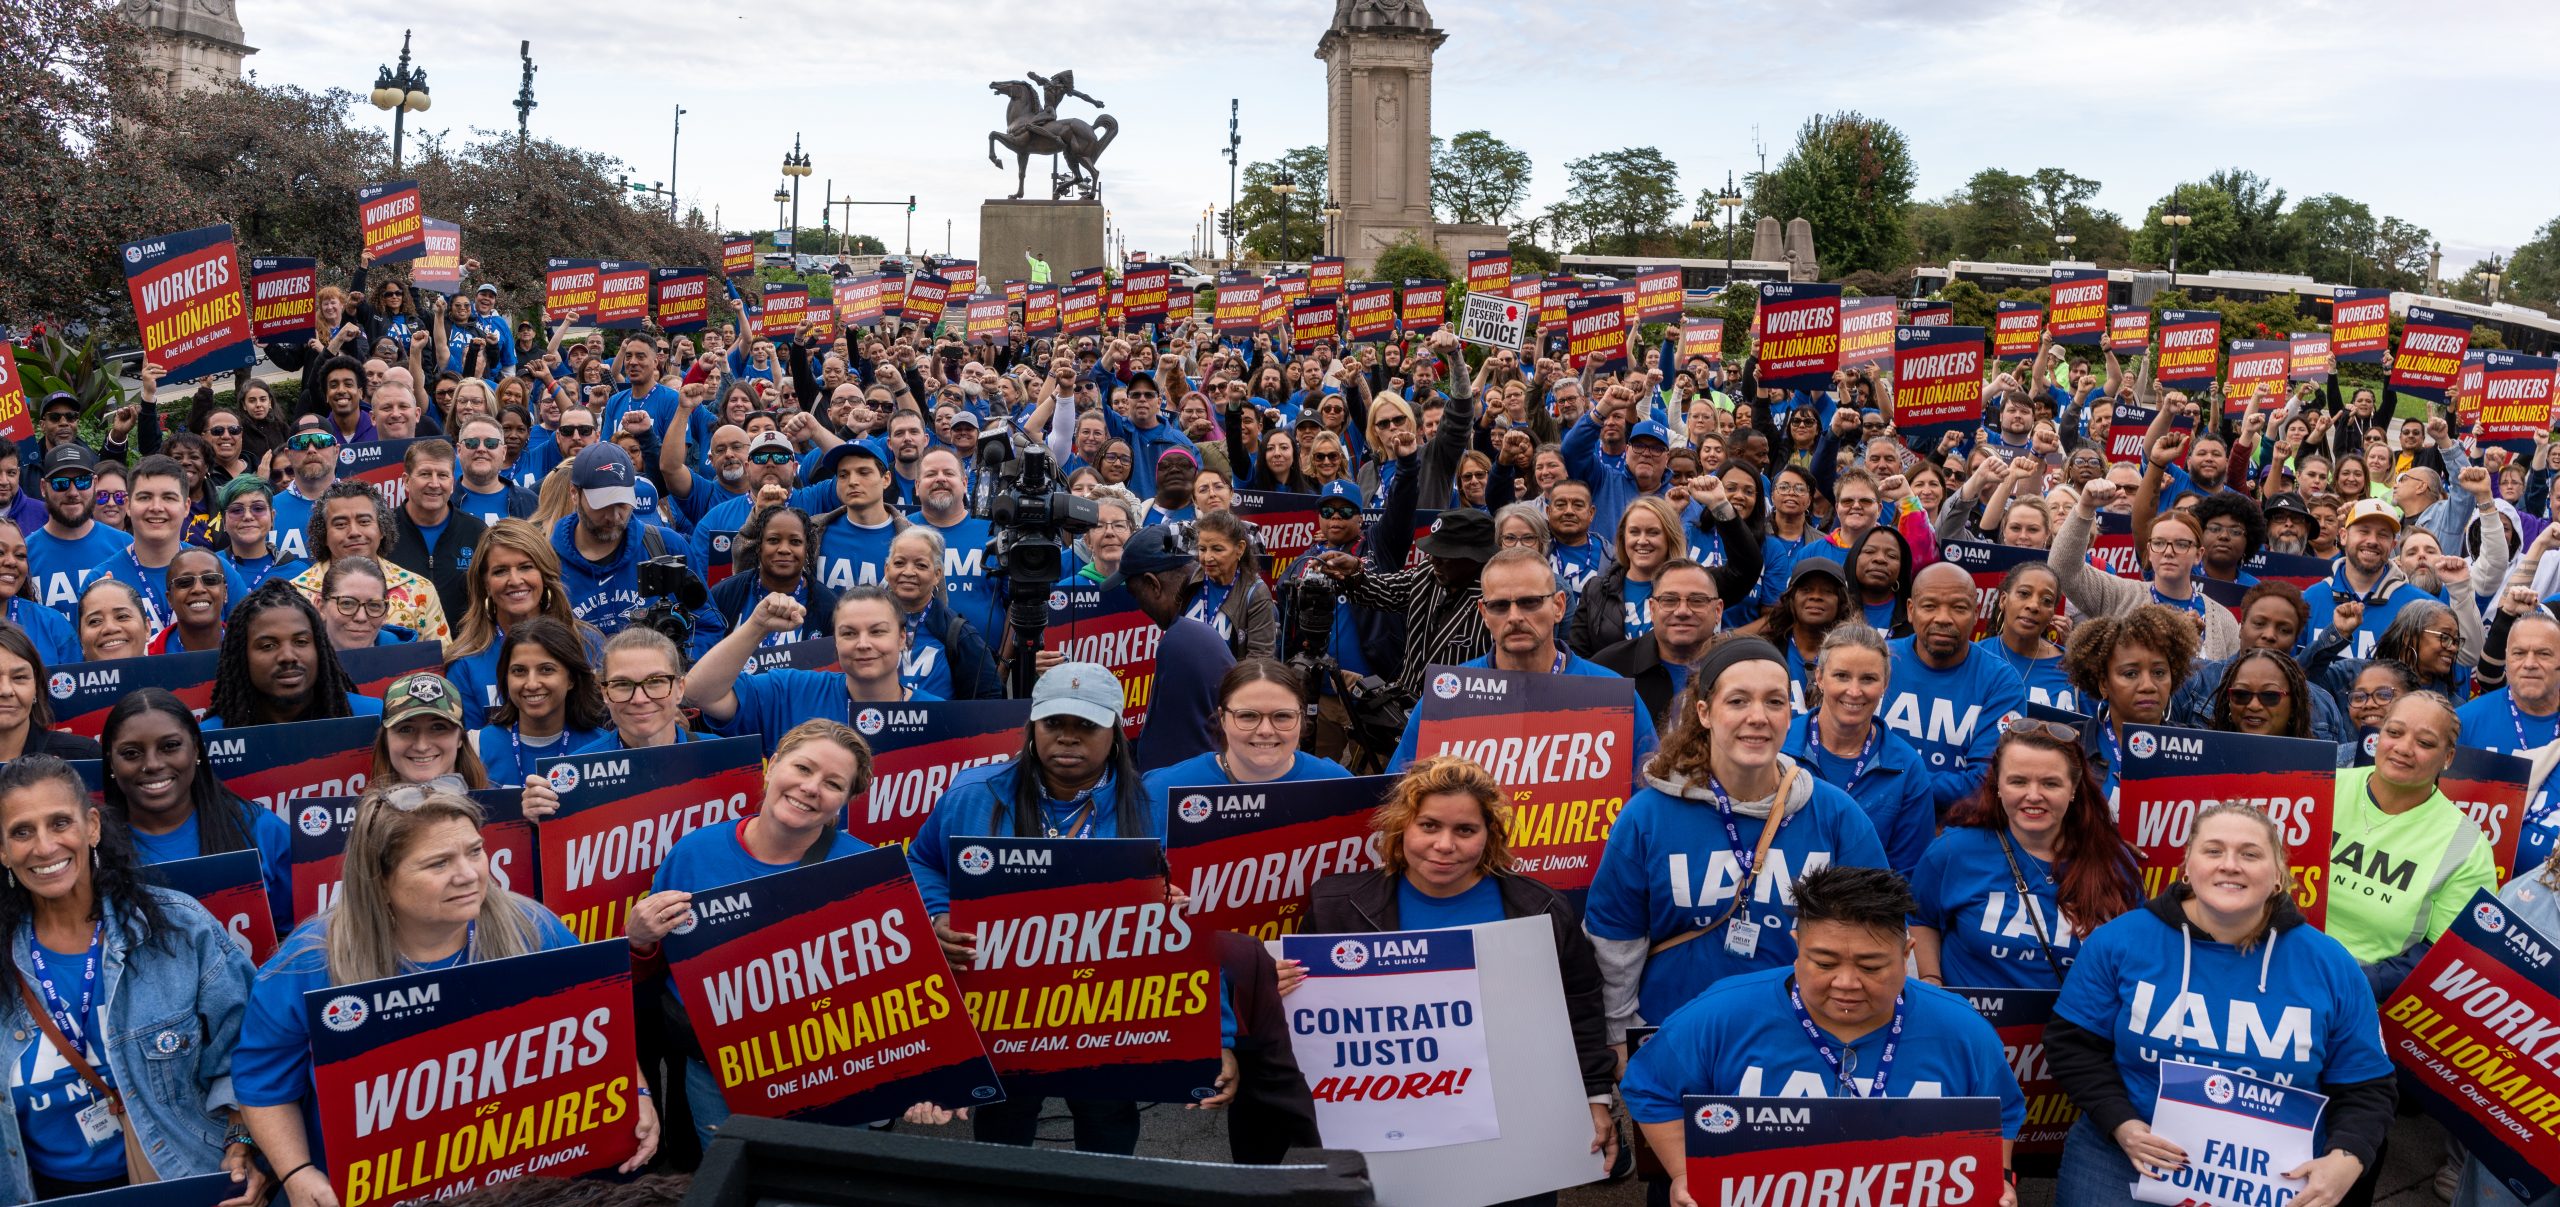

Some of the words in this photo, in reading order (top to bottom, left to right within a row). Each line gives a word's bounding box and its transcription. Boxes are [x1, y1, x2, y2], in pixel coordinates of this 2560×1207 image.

[366, 196, 414, 226] WORKERS
[366, 214, 420, 246] BILLIONAIRES
[142, 241, 166, 254] IAM
[725, 244, 751, 256] WORKERS
[724, 254, 752, 267] BILLIONAIRES
[1313, 266, 1342, 276] WORKERS
[141, 256, 229, 314] WORKERS
[257, 276, 310, 300] WORKERS
[551, 273, 594, 291] WORKERS
[602, 276, 645, 294] WORKERS
[662, 282, 703, 299] WORKERS
[1311, 276, 1342, 288] BILLIONAIRES
[1640, 276, 1678, 293] WORKERS
[548, 290, 597, 309] BILLIONAIRES
[599, 292, 647, 311] BILLIONAIRES
[844, 285, 879, 301] WORKERS
[912, 285, 946, 300] WORKERS
[1220, 289, 1259, 304] WORKERS
[1406, 288, 1441, 304] WORKERS
[1638, 291, 1680, 308] BILLIONAIRES
[2055, 285, 2103, 304] WORKERS
[254, 298, 314, 322] BILLIONAIRES
[659, 298, 706, 316] BILLIONAIRES
[766, 297, 804, 311] WORKERS
[842, 299, 881, 314] BILLIONAIRES
[906, 299, 944, 313] BILLIONAIRES
[1062, 294, 1096, 310] WORKERS
[1216, 303, 1260, 318] BILLIONAIRES
[1352, 294, 1390, 310] WORKERS
[1403, 302, 1442, 319] BILLIONAIRES
[1471, 298, 1503, 312] DRIVERS
[971, 305, 1005, 318] WORKERS
[1064, 308, 1099, 324] BILLIONAIRES
[1297, 310, 1332, 325] WORKERS
[1350, 309, 1392, 326] BILLIONAIRES
[1469, 308, 1505, 323] DESERVE
[1766, 306, 1834, 334] WORKERS
[2052, 304, 2105, 324] BILLIONAIRES
[2338, 304, 2385, 323] WORKERS
[146, 291, 241, 352] BILLIONAIRES
[968, 317, 1006, 331] BILLIONAIRES
[1572, 310, 1619, 336] WORKERS
[1842, 311, 1892, 333] WORKERS
[2000, 316, 2038, 330] WORKERS
[2114, 316, 2147, 328] WORKERS
[1468, 319, 1473, 327] A
[1475, 321, 1518, 344] VOICE
[1840, 329, 1896, 352] BILLIONAIRES
[1912, 330, 1930, 338] IAM
[1996, 329, 2039, 344] BILLIONAIRES
[2164, 328, 2214, 348] WORKERS
[2334, 322, 2386, 342] BILLIONAIRES
[1571, 330, 1624, 355] BILLIONAIRES
[1761, 334, 1838, 360] BILLIONAIRES
[2404, 331, 2463, 354] WORKERS
[1902, 351, 1976, 381] WORKERS
[2160, 348, 2215, 367] BILLIONAIRES
[2396, 354, 2460, 375] BILLIONAIRES
[2498, 355, 2514, 363] IAM
[2233, 358, 2283, 378] WORKERS
[1896, 380, 1980, 408] BILLIONAIRES
[2487, 378, 2549, 400] WORKERS
[2128, 409, 2145, 418] IAM
[2482, 404, 2548, 423] BILLIONAIRES
[1652, 425, 1665, 433] IAM
[357, 446, 382, 457] IAM
[1243, 495, 1263, 504] IAM
[1964, 548, 1990, 560] IAM
[573, 592, 608, 619] BLUE
[611, 589, 645, 605] JAYS
[1071, 592, 1099, 603] IAM
[759, 651, 791, 663] IAM
[765, 662, 789, 670] UNION
[79, 669, 120, 687] IAM
[1464, 676, 1507, 694] IAM
[84, 686, 117, 694] UNION
[888, 710, 927, 725] IAM
[2161, 736, 2203, 754] IAM
[584, 759, 630, 779] IAM
[589, 779, 626, 787] UNION
[1217, 794, 1265, 812] IAM
[999, 849, 1052, 867] IAM
[1669, 849, 1831, 908] IAM
[699, 892, 752, 918] IAM
[710, 911, 750, 925] UNION
[974, 903, 1192, 971] WORKERS
[2504, 924, 2552, 967] IAM
[1374, 939, 1428, 958] IAM
[2505, 940, 2538, 969] UNION
[703, 908, 911, 1027] WORKERS
[374, 983, 440, 1012] IAM
[964, 970, 1209, 1032] BILLIONAIRES
[383, 1005, 436, 1020] UNION
[1294, 1001, 1472, 1034] CONTRATO
[2128, 980, 2311, 1062] IAM
[718, 974, 950, 1088] BILLIONAIRES
[1029, 1034, 1070, 1051] IAM.
[1334, 1037, 1438, 1068] JUSTO
[354, 1007, 611, 1138] WORKERS
[801, 1065, 838, 1088] IAM.
[1312, 1068, 1472, 1103] AHORA!
[2238, 1082, 2284, 1106] IAM
[1746, 1107, 1811, 1124] IAM
[2241, 1101, 2275, 1113] UNION
[346, 1076, 629, 1207] BILLIONAIRES
[2203, 1139, 2270, 1176] FAIR
[1719, 1154, 1977, 1207] WORKERS
